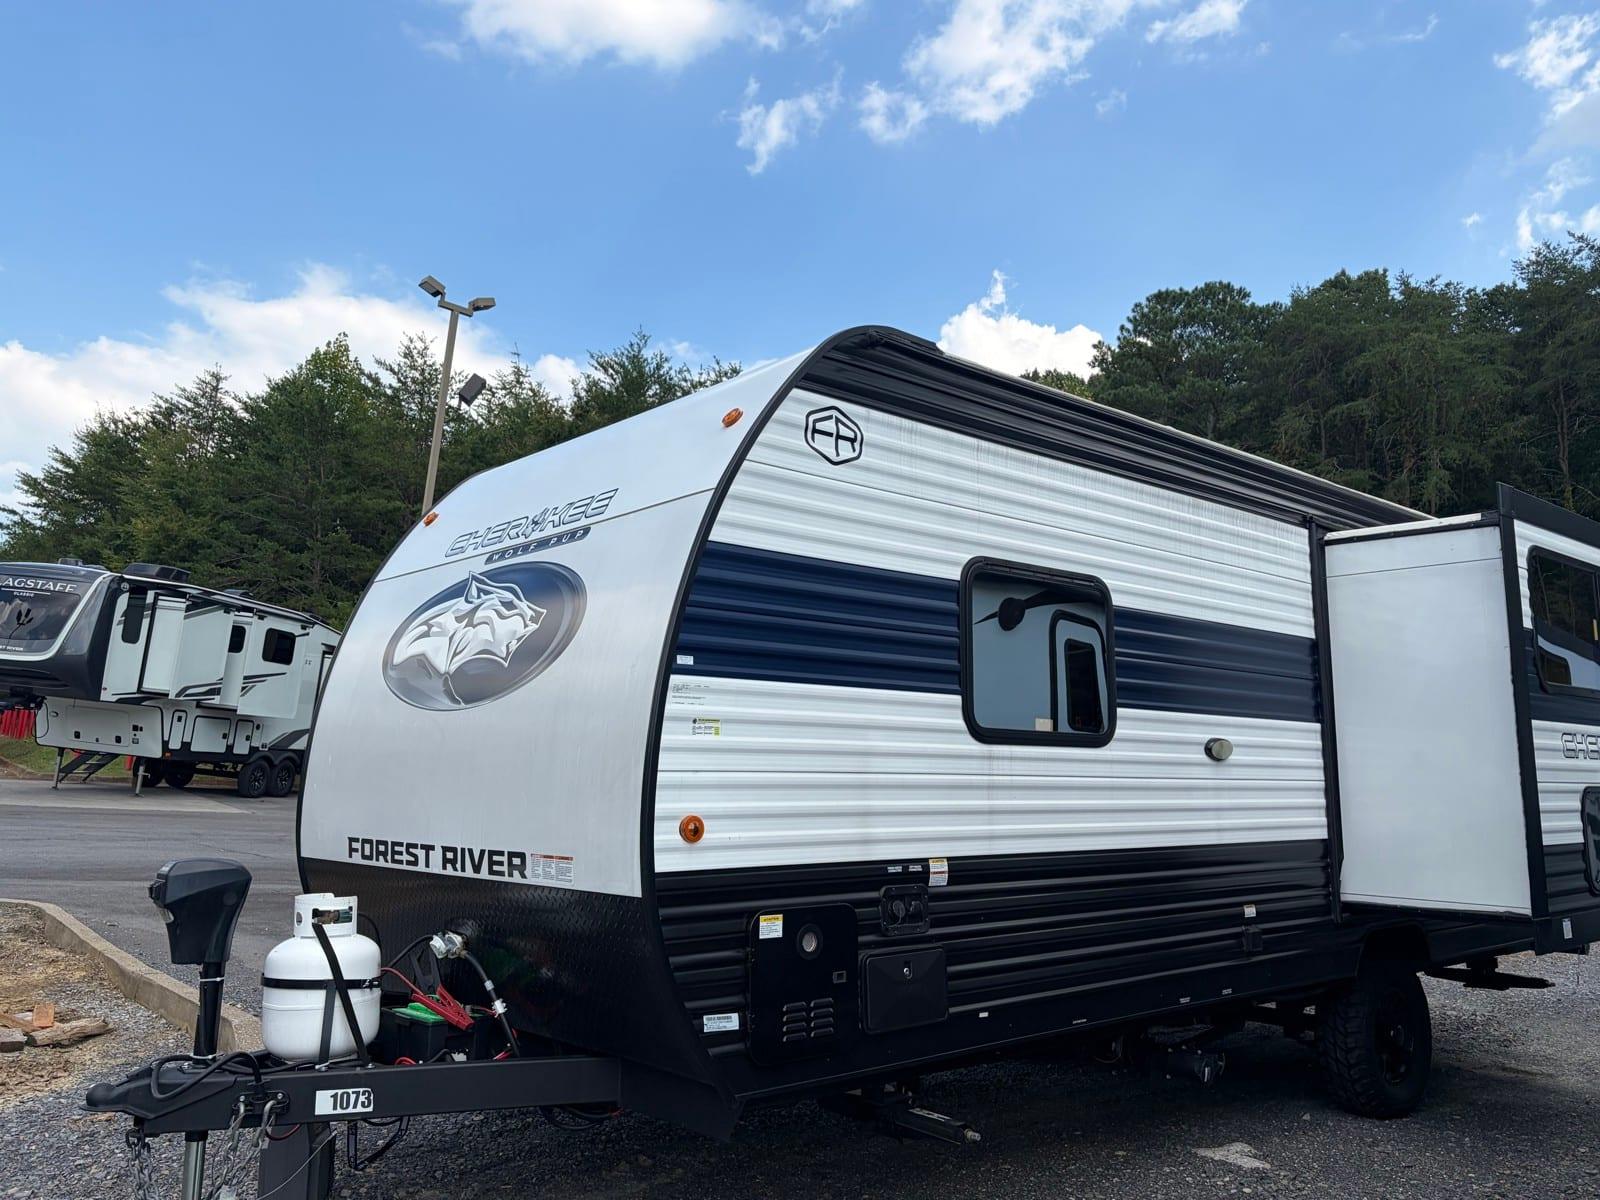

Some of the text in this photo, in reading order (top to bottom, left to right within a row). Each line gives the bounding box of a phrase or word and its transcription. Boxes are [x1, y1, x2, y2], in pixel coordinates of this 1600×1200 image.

[492, 529, 584, 562] WOLF PUP
[1561, 732, 1600, 760] CHE
[347, 836, 436, 868] FOREST
[440, 845, 528, 879] RIVER
[330, 1089, 372, 1111] 1073
